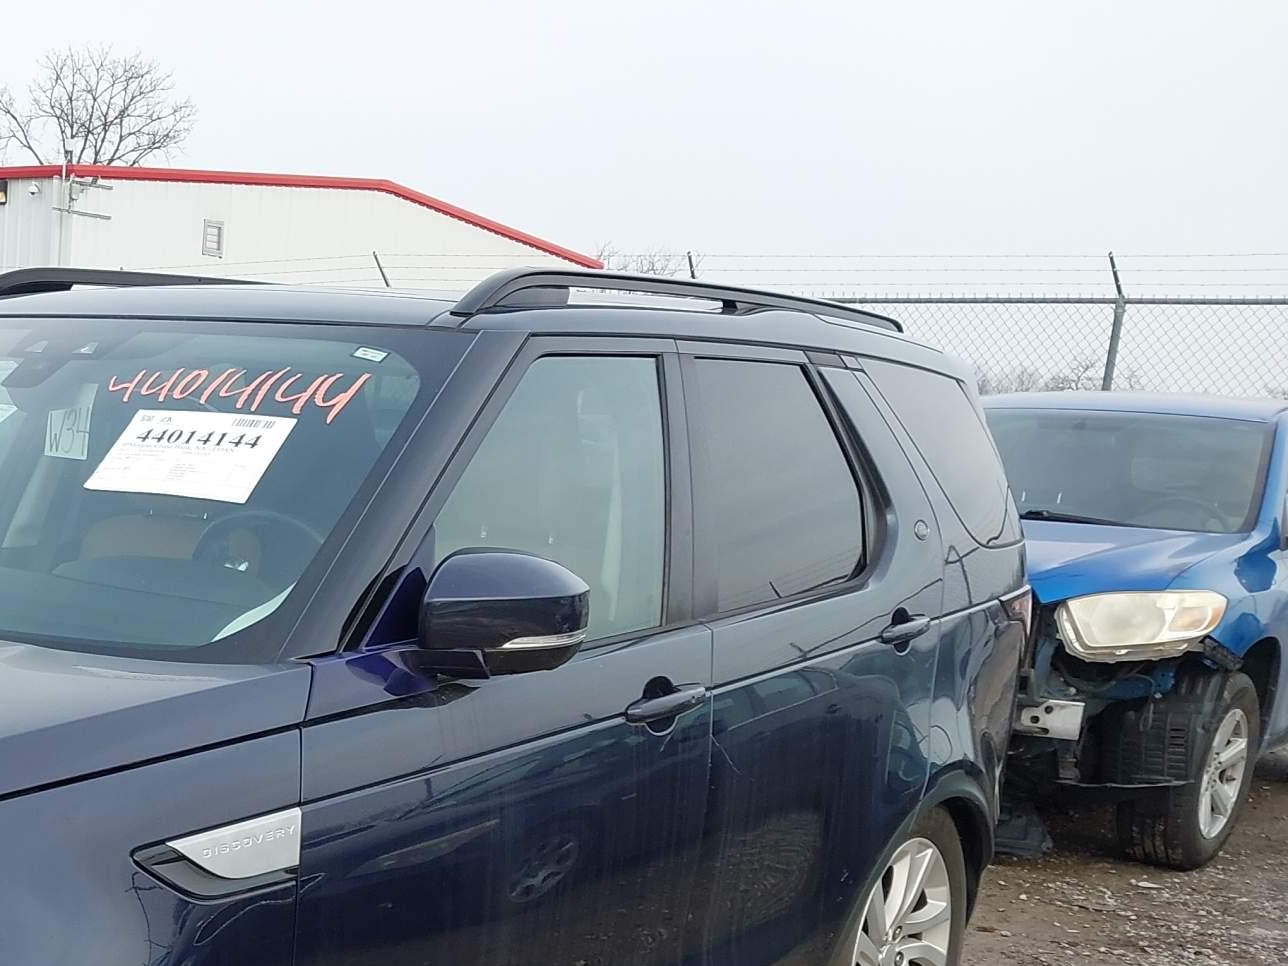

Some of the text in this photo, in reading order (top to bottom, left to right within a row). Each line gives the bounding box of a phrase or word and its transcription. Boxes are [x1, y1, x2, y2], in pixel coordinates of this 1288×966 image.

[108, 366, 372, 425] 44014144
[49, 407, 90, 457] W34
[136, 428, 262, 449] 44014144
[202, 825, 295, 858] DISCOVERY
